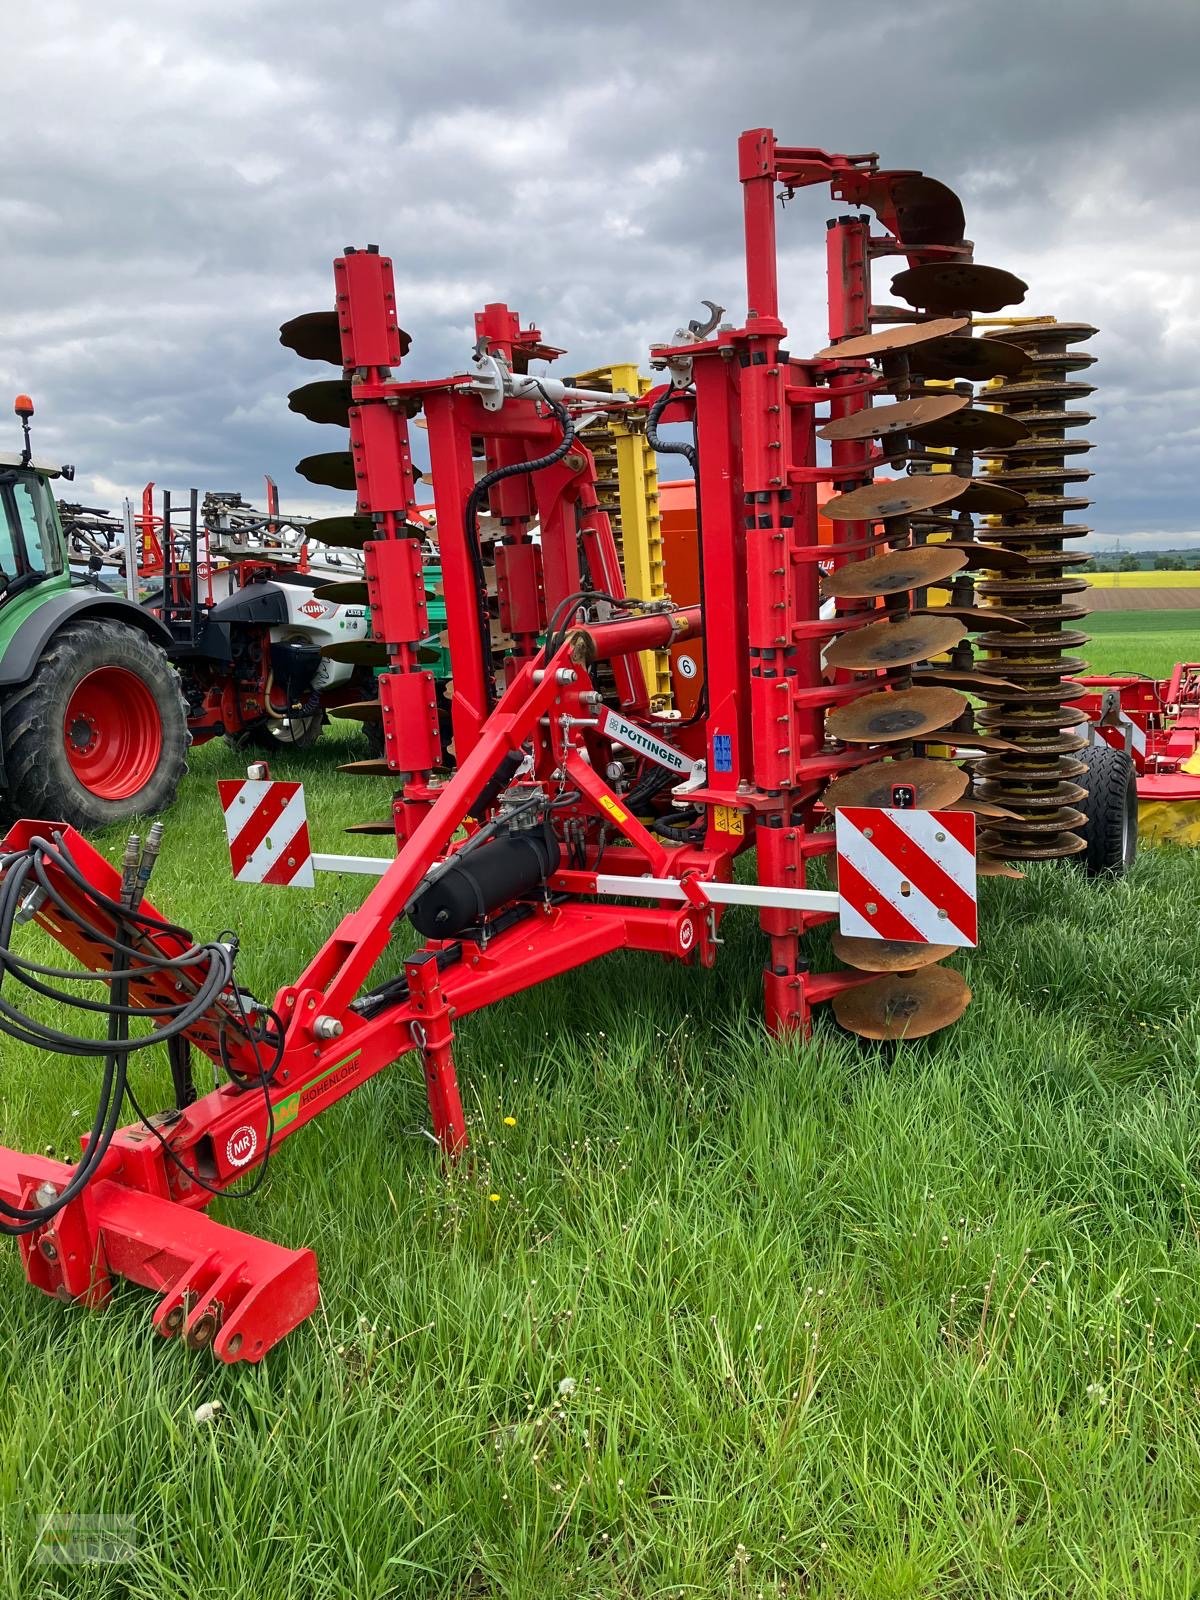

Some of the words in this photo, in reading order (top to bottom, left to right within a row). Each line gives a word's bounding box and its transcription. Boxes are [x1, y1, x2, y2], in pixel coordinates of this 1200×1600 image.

[301, 604, 326, 614] KUHN
[682, 660, 691, 674] 6
[619, 724, 683, 769] PÖTTINGER
[301, 1059, 360, 1105] HOHENLOHE
[233, 1135, 250, 1156] MR
